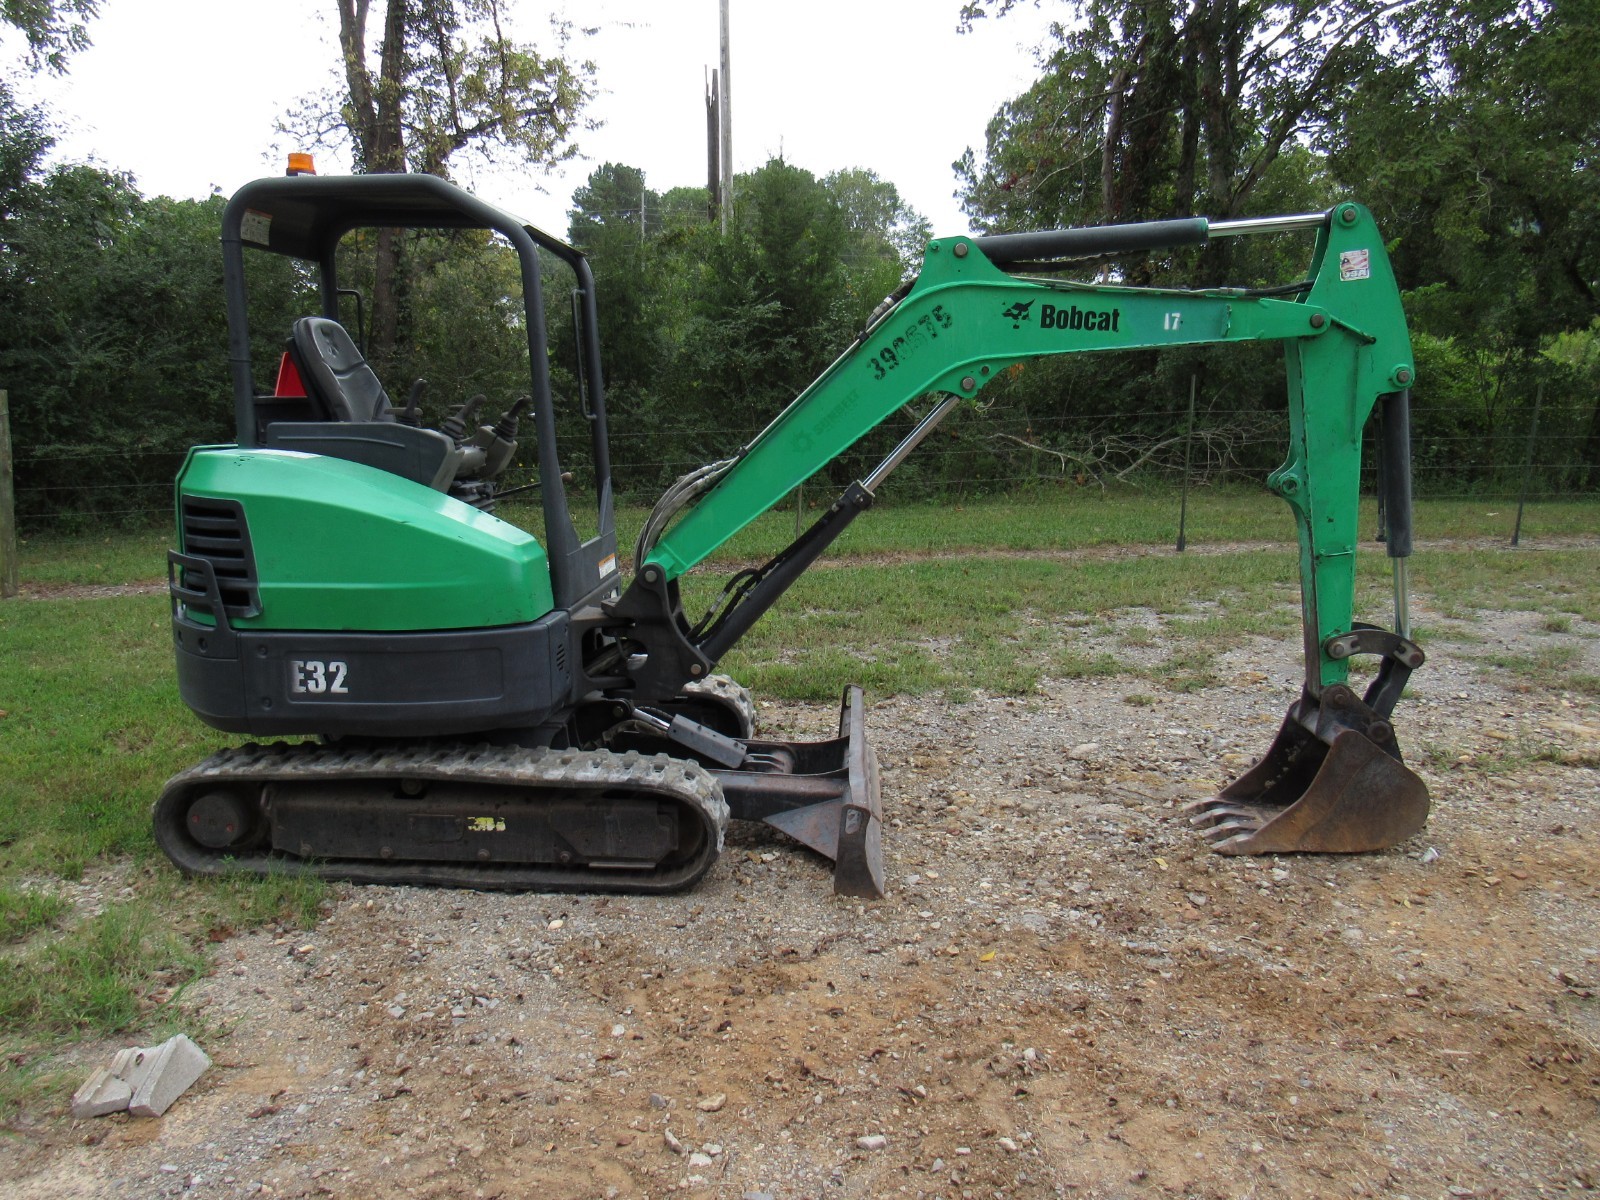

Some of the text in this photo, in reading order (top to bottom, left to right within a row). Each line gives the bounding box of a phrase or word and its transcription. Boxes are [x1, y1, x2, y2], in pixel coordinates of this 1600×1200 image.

[1040, 304, 1120, 333] Bobcat
[1163, 312, 1181, 331] 17
[291, 660, 349, 693] E32
